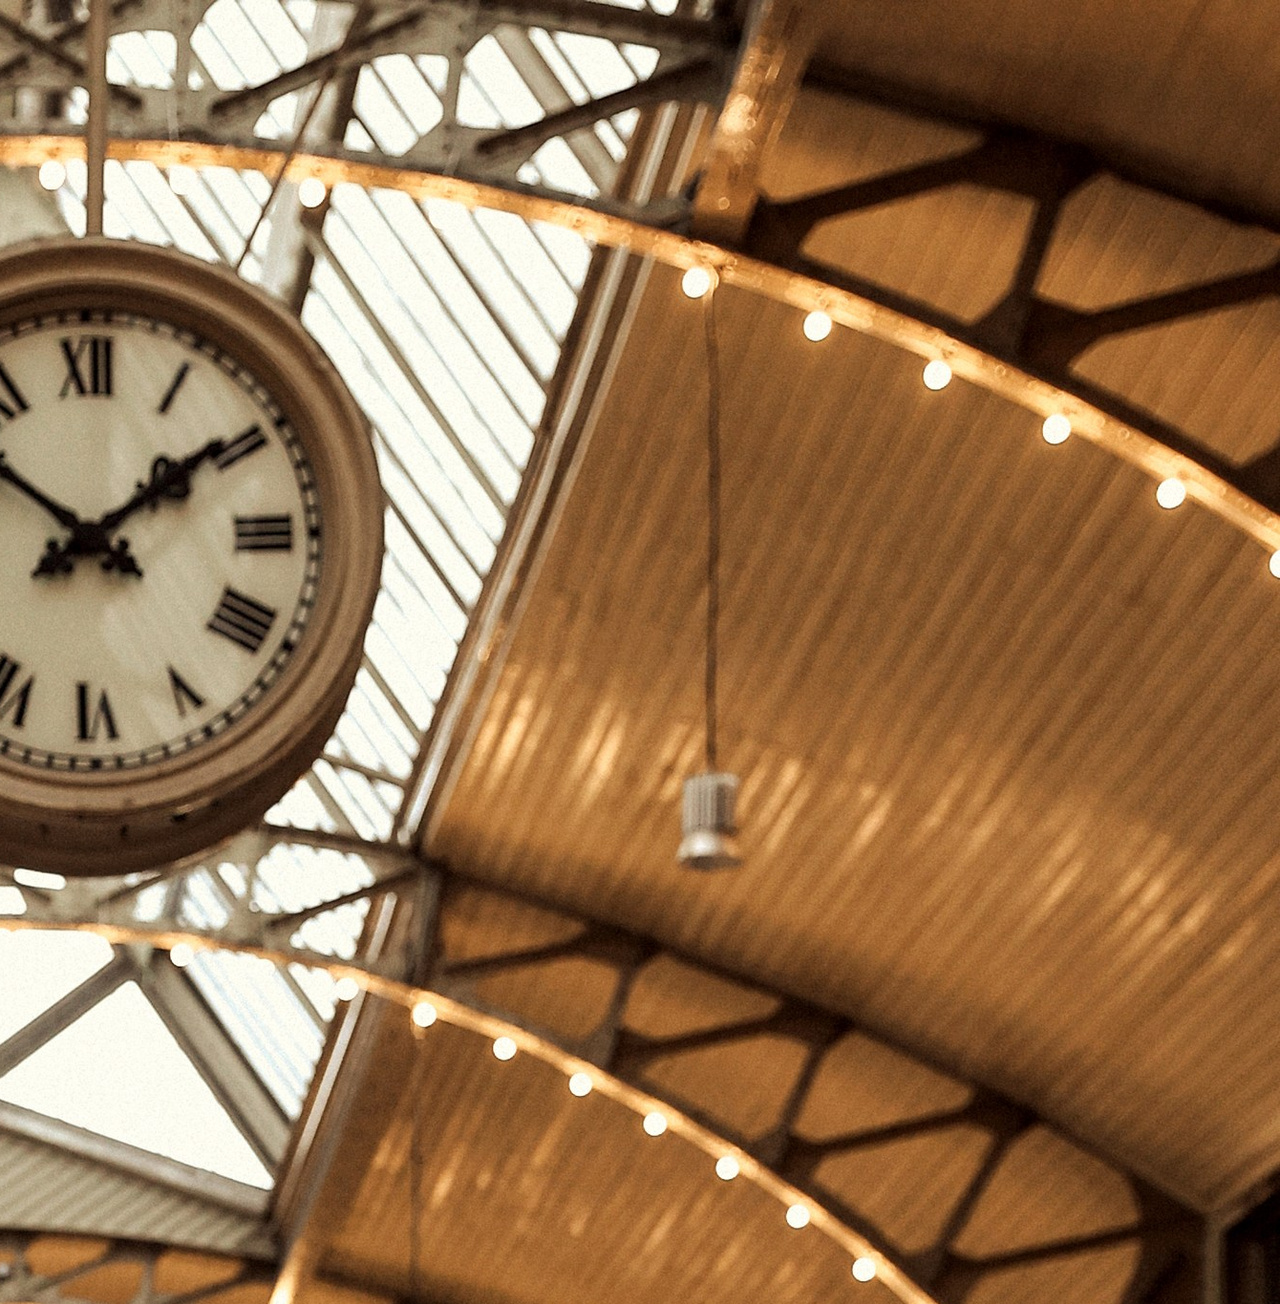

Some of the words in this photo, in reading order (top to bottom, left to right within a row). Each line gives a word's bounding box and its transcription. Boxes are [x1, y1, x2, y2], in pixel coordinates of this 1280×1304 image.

[59, 336, 113, 398] XII
[217, 424, 268, 472] II
[234, 514, 292, 552] III
[207, 586, 277, 653] IIII
[76, 682, 119, 741] VI
[167, 664, 206, 718] V
